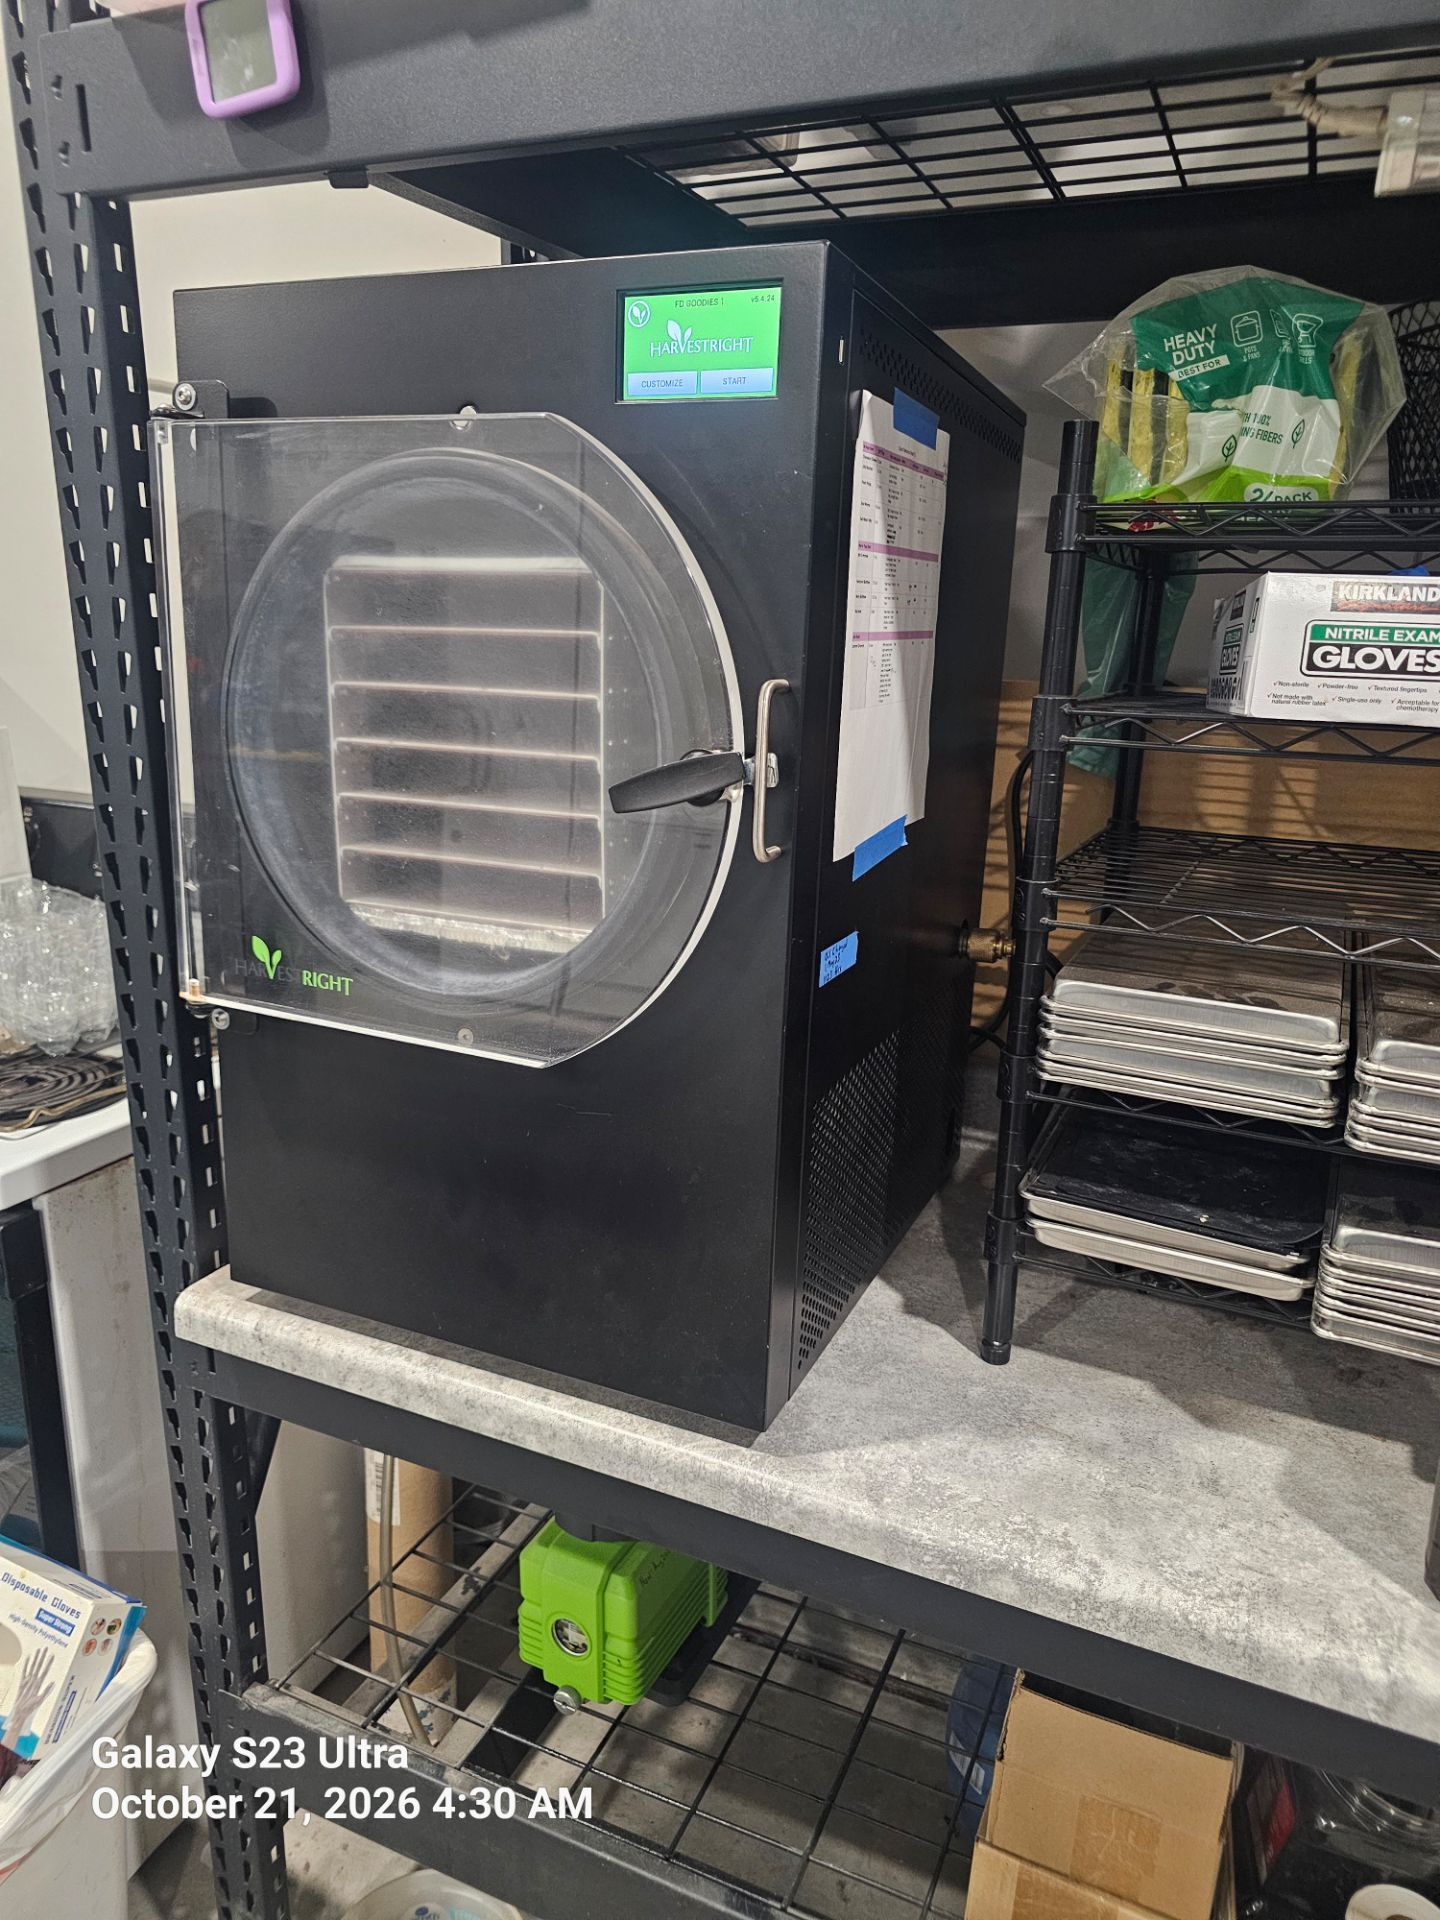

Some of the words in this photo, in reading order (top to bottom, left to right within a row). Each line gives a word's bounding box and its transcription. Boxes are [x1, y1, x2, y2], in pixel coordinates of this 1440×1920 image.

[675, 300, 684, 308] FD
[686, 298, 719, 308] GOODIES
[1163, 323, 1218, 352] HEAVY
[1172, 340, 1216, 366] DUTY
[1203, 358, 1222, 370] FOR
[641, 378, 683, 388] CUSTOMIZE
[722, 376, 747, 386] START
[1255, 428, 1284, 445] FIBERS
[1338, 584, 1440, 602] KIRKLAND
[1325, 627, 1390, 641] NITRILE
[1393, 629, 1440, 643] EXAM
[1312, 645, 1440, 673] GLOVES
[1396, 705, 1438, 713] chemotherapy
[302, 969, 354, 996] RIGHT
[1, 1572, 48, 1602] Disposable
[51, 1596, 81, 1619] Gloves
